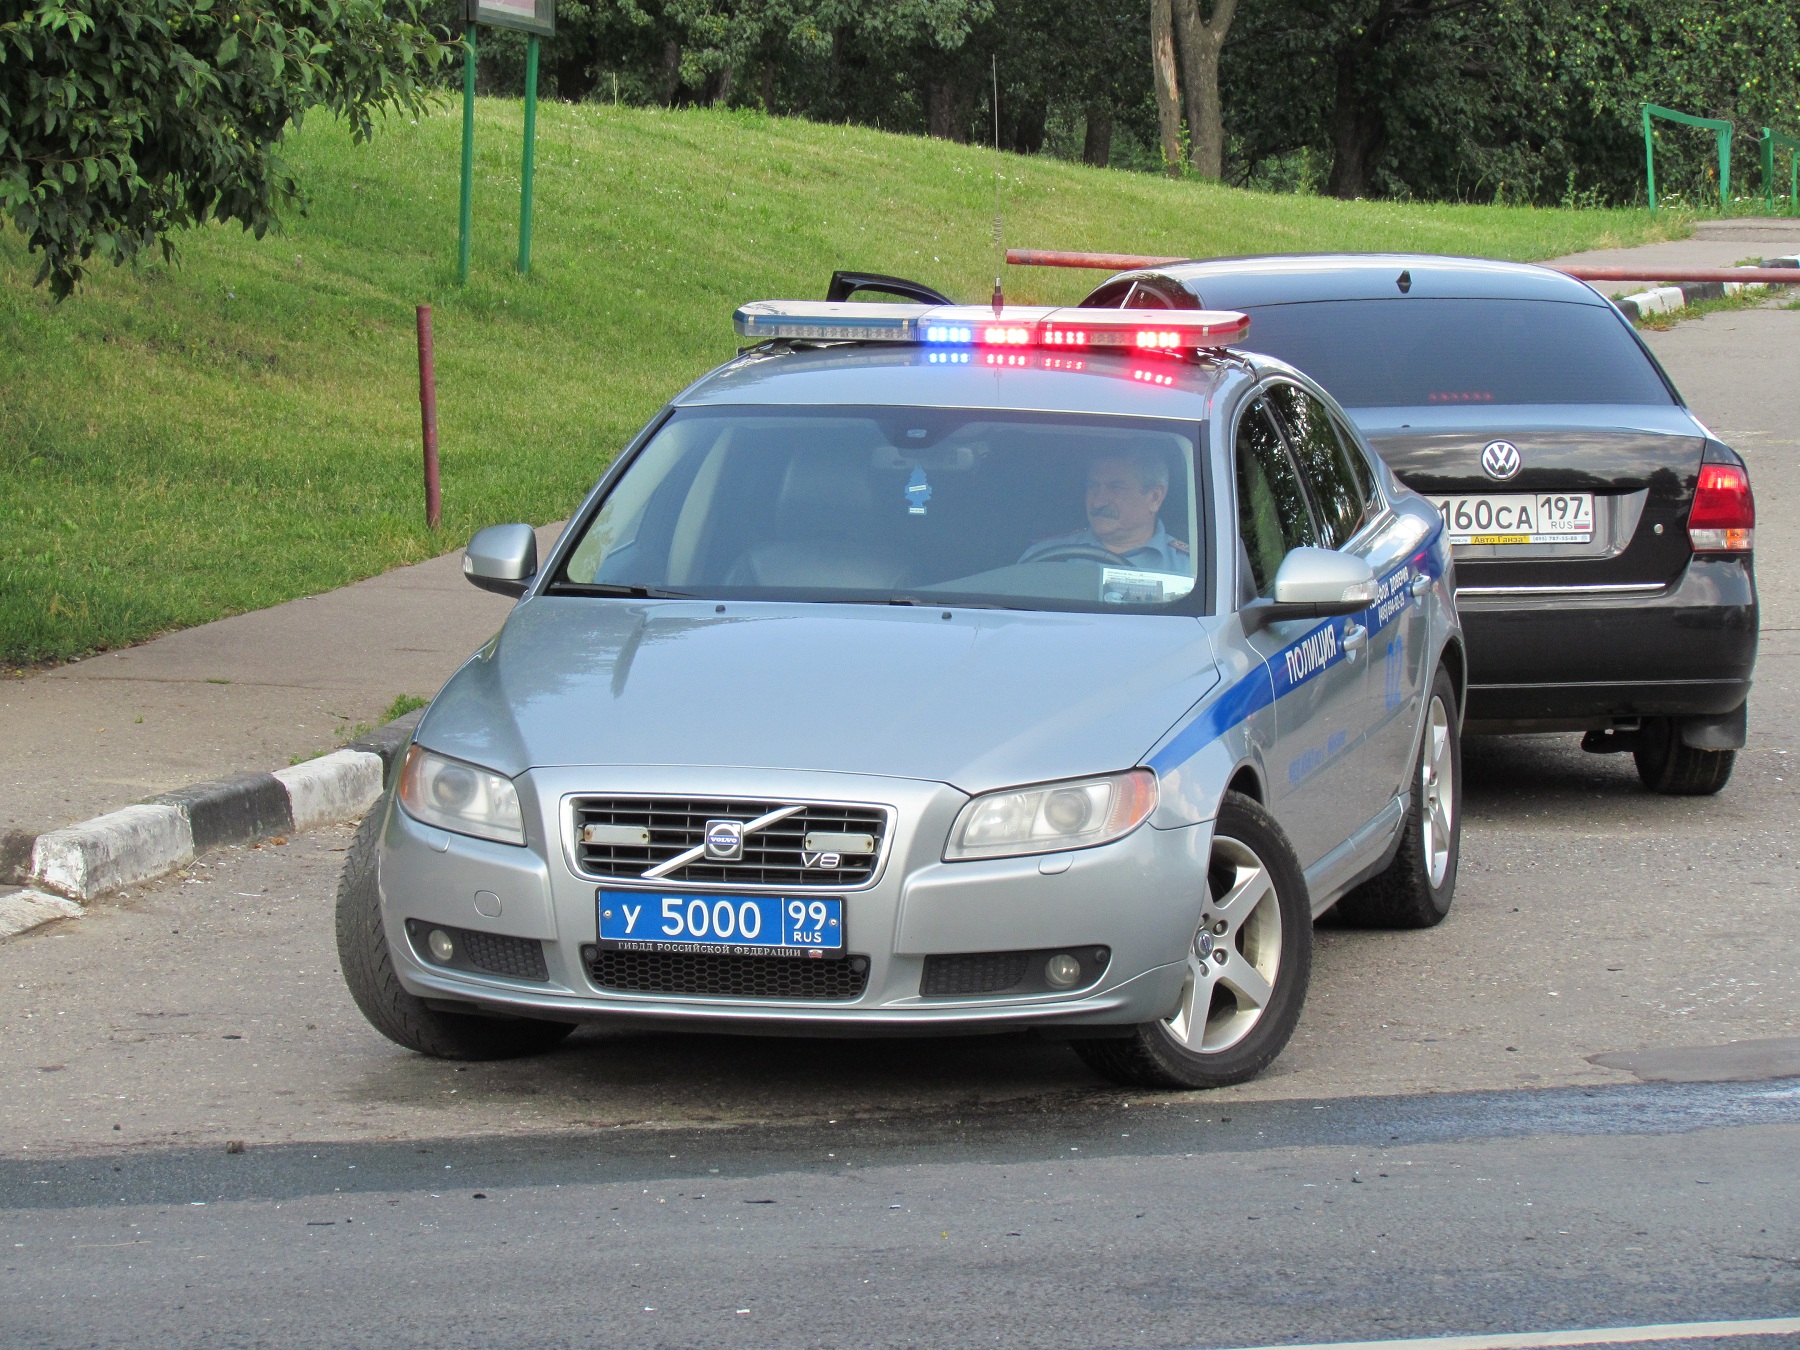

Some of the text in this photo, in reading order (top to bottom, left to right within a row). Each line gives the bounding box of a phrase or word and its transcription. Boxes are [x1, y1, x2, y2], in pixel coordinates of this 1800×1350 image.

[1440, 499, 1533, 530] 160СА
[1540, 496, 1584, 520] 197
[1551, 521, 1573, 530] RUS
[1473, 535, 1496, 544] Авто
[1285, 624, 1337, 684] ПОЛИЦИЯ
[710, 836, 738, 844] VOLVO
[801, 851, 841, 868] V8
[661, 898, 761, 938] 5000
[788, 901, 827, 930] 99
[793, 931, 822, 943] RUS
[618, 942, 801, 958] ГИБДД РОССИЙСКОЙ ФЕДЕРАЦИИ
